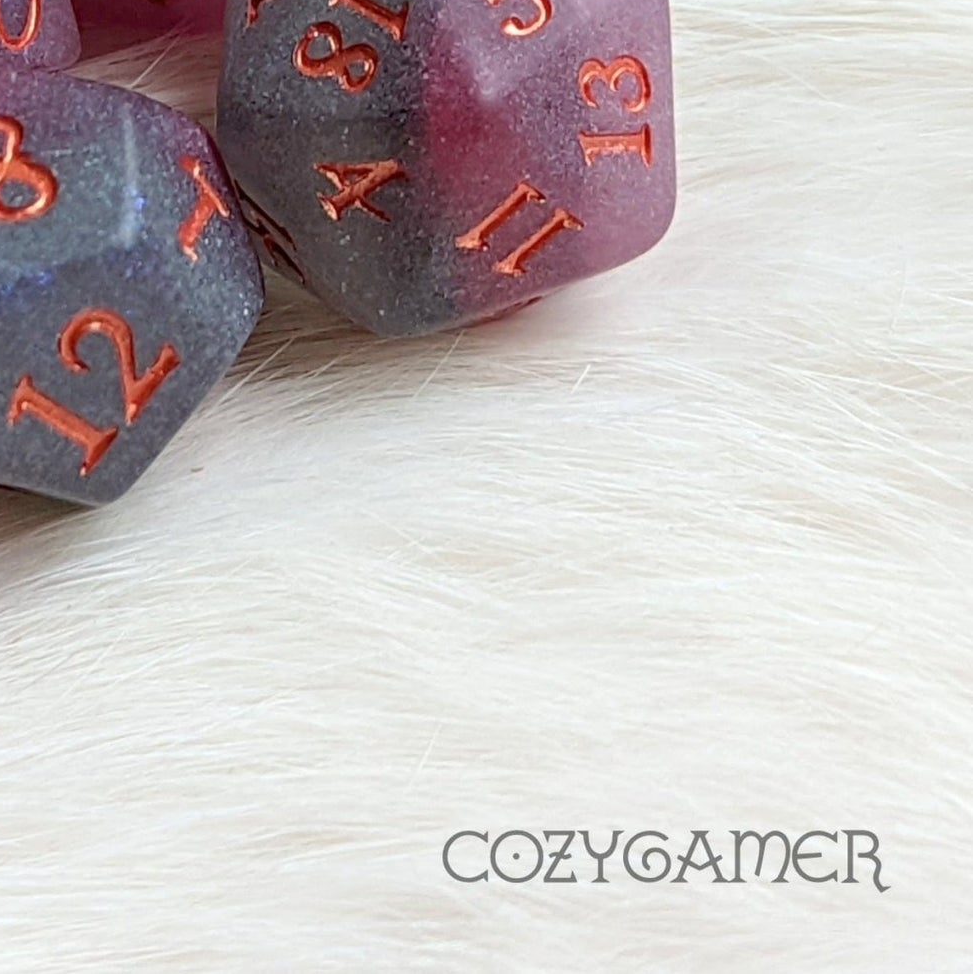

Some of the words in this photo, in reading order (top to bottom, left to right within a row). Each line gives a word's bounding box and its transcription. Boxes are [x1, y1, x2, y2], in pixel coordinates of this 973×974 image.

[576, 53, 655, 169] 13
[313, 157, 414, 224] 4
[6, 306, 183, 478] 12
